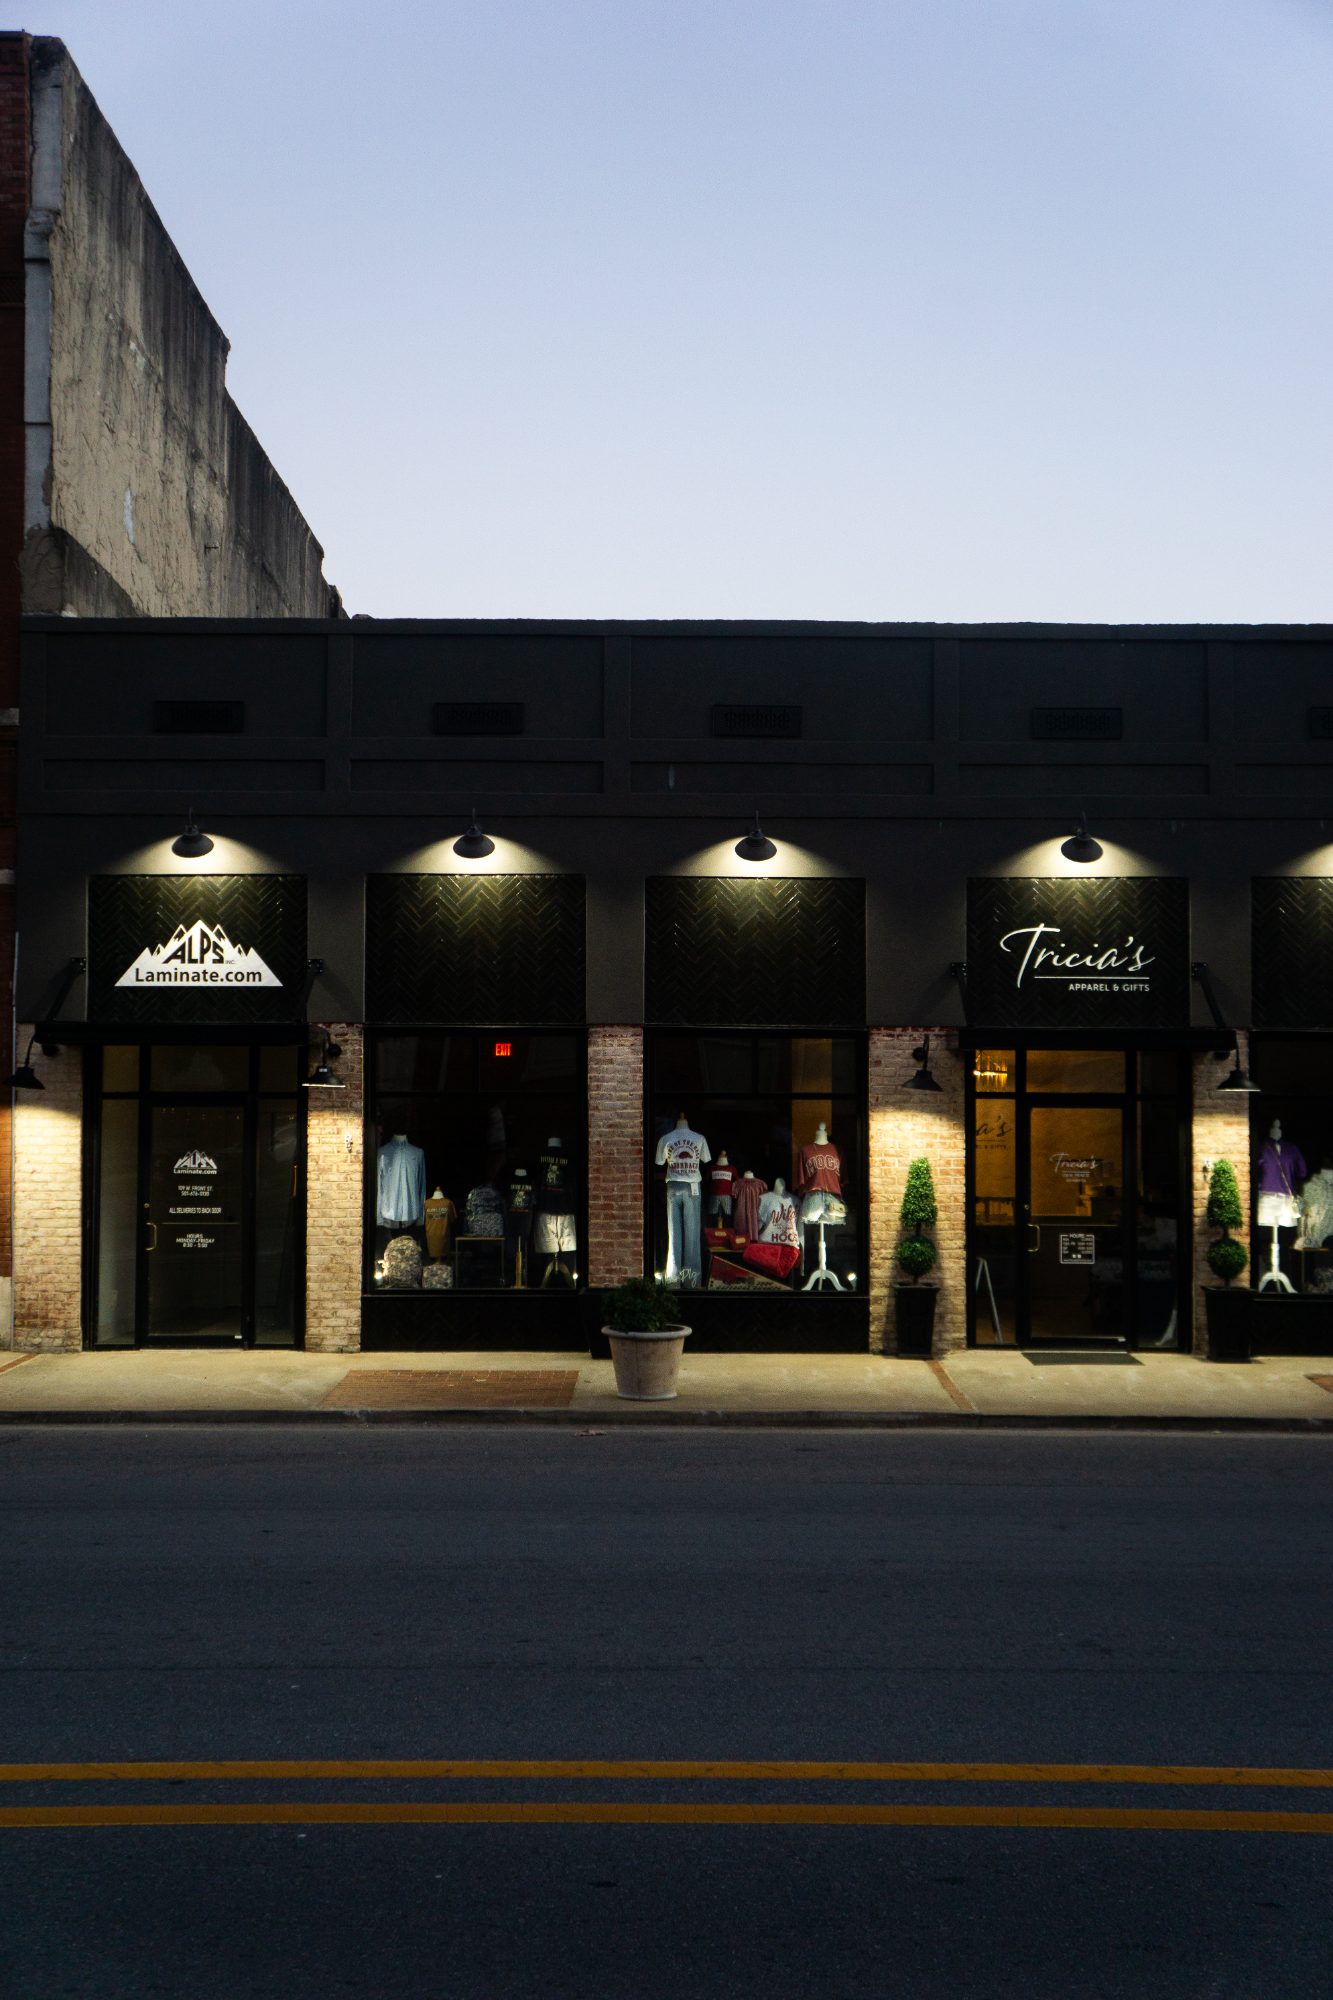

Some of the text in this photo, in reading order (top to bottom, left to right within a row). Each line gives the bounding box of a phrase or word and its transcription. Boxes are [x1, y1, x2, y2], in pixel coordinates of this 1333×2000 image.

[162, 928, 225, 965] ALPS
[999, 922, 1156, 989] Tricia's
[135, 968, 262, 983] Laminate.com
[1068, 983, 1150, 992] APPAREL & GIFTS
[495, 1043, 512, 1056] EXIT
[178, 1151, 207, 1168] ALPS
[1049, 1152, 1100, 1174] Tricia's
